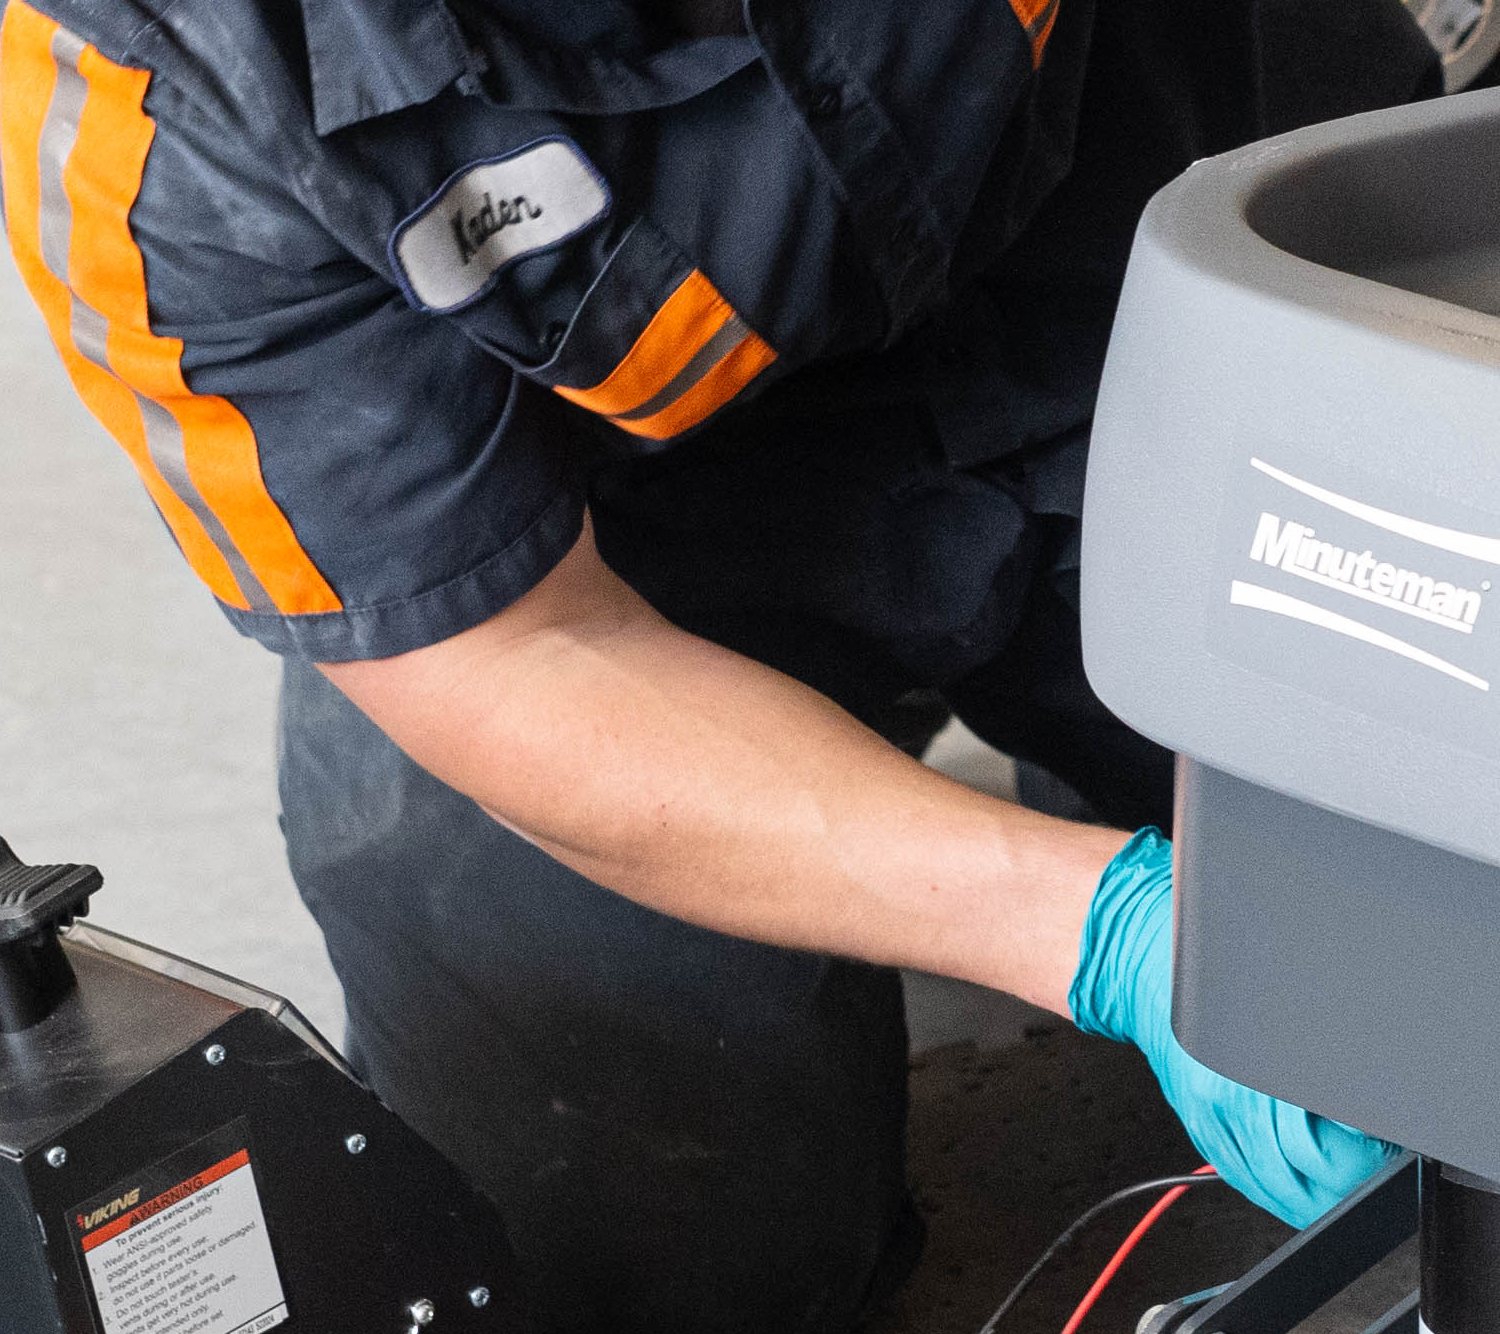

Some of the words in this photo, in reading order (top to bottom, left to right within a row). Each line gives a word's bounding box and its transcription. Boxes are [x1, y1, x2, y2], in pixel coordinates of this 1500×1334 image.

[1249, 512, 1482, 627] Minuteman
[84, 1188, 139, 1228] VIKING
[139, 1176, 203, 1221] WARNING
[102, 1253, 124, 1268] Wear
[189, 1206, 212, 1222] safety
[115, 1238, 127, 1247] To
[128, 1218, 161, 1242] prevent
[162, 1201, 194, 1221] serious
[106, 1260, 138, 1283] goggles
[139, 1244, 165, 1262] during
[109, 1273, 139, 1293] Inspect
[140, 1259, 166, 1277] before
[168, 1246, 189, 1261] every
[113, 1295, 123, 1305] do
[125, 1286, 139, 1298] not
[140, 1278, 154, 1290] use
[156, 1272, 161, 1281] if
[163, 1262, 183, 1279] parts
[185, 1249, 206, 1264] loose
[208, 1244, 216, 1252] or
[115, 1308, 128, 1319] Do
[129, 1298, 143, 1311] not
[144, 1286, 167, 1302] touch
[119, 1315, 141, 1329] vents
[142, 1299, 168, 1317] during
[169, 1293, 177, 1302] or
[180, 1282, 196, 1296] after
[146, 1315, 160, 1330] get
[161, 1306, 178, 1319] very
[194, 1283, 220, 1301] during
[210, 1309, 223, 1321] set
